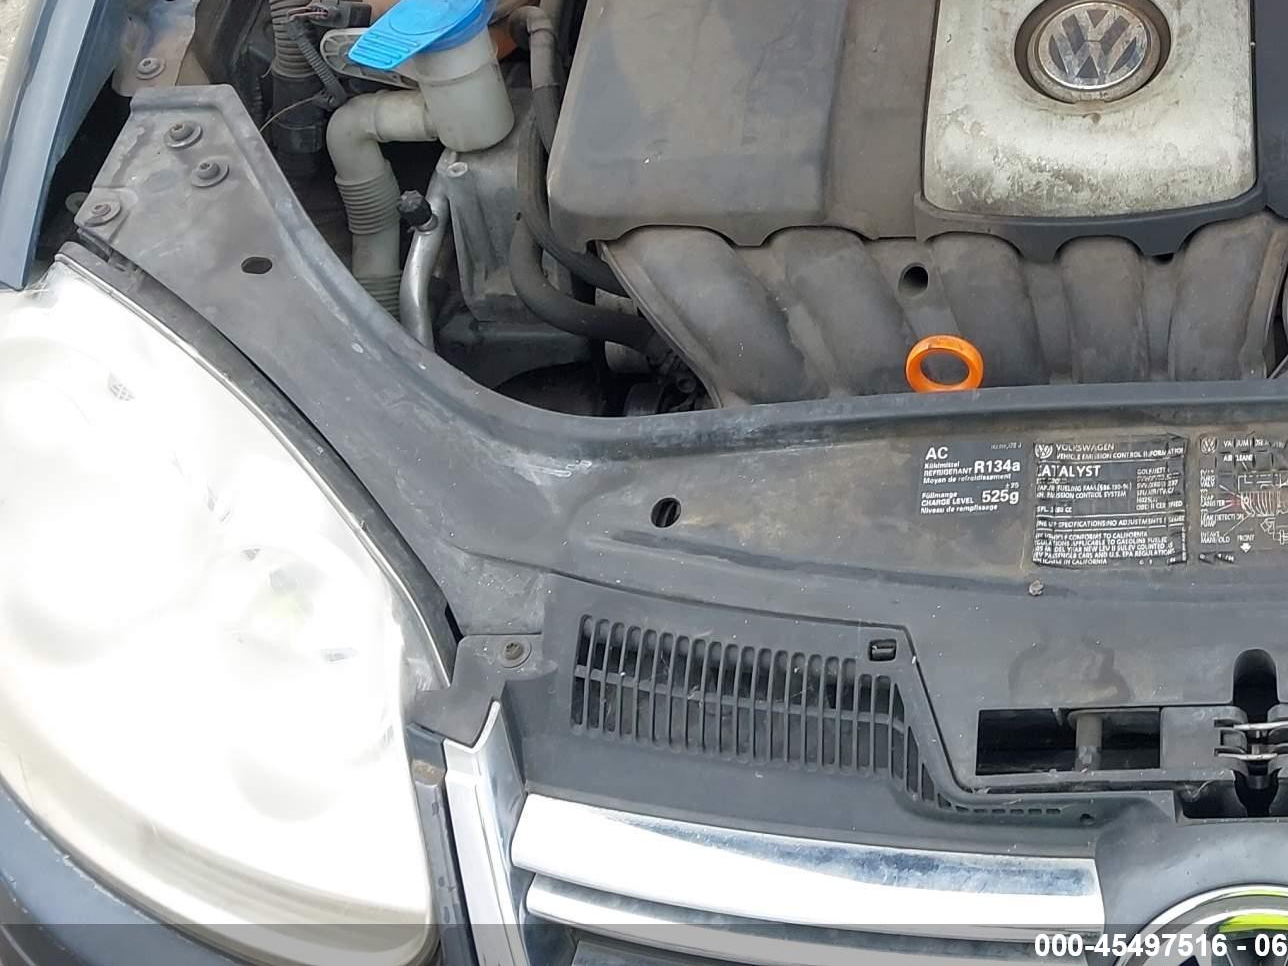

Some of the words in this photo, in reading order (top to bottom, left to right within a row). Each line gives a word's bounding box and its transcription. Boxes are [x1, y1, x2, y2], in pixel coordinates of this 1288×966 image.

[925, 446, 948, 460] AC
[974, 459, 1020, 474] R134a
[924, 468, 972, 476] REFRIGERANT
[923, 476, 946, 484] Moyen
[982, 490, 1020, 504] 525g
[1103, 490, 1126, 498] SYSTEM
[921, 498, 950, 506] CHARGE
